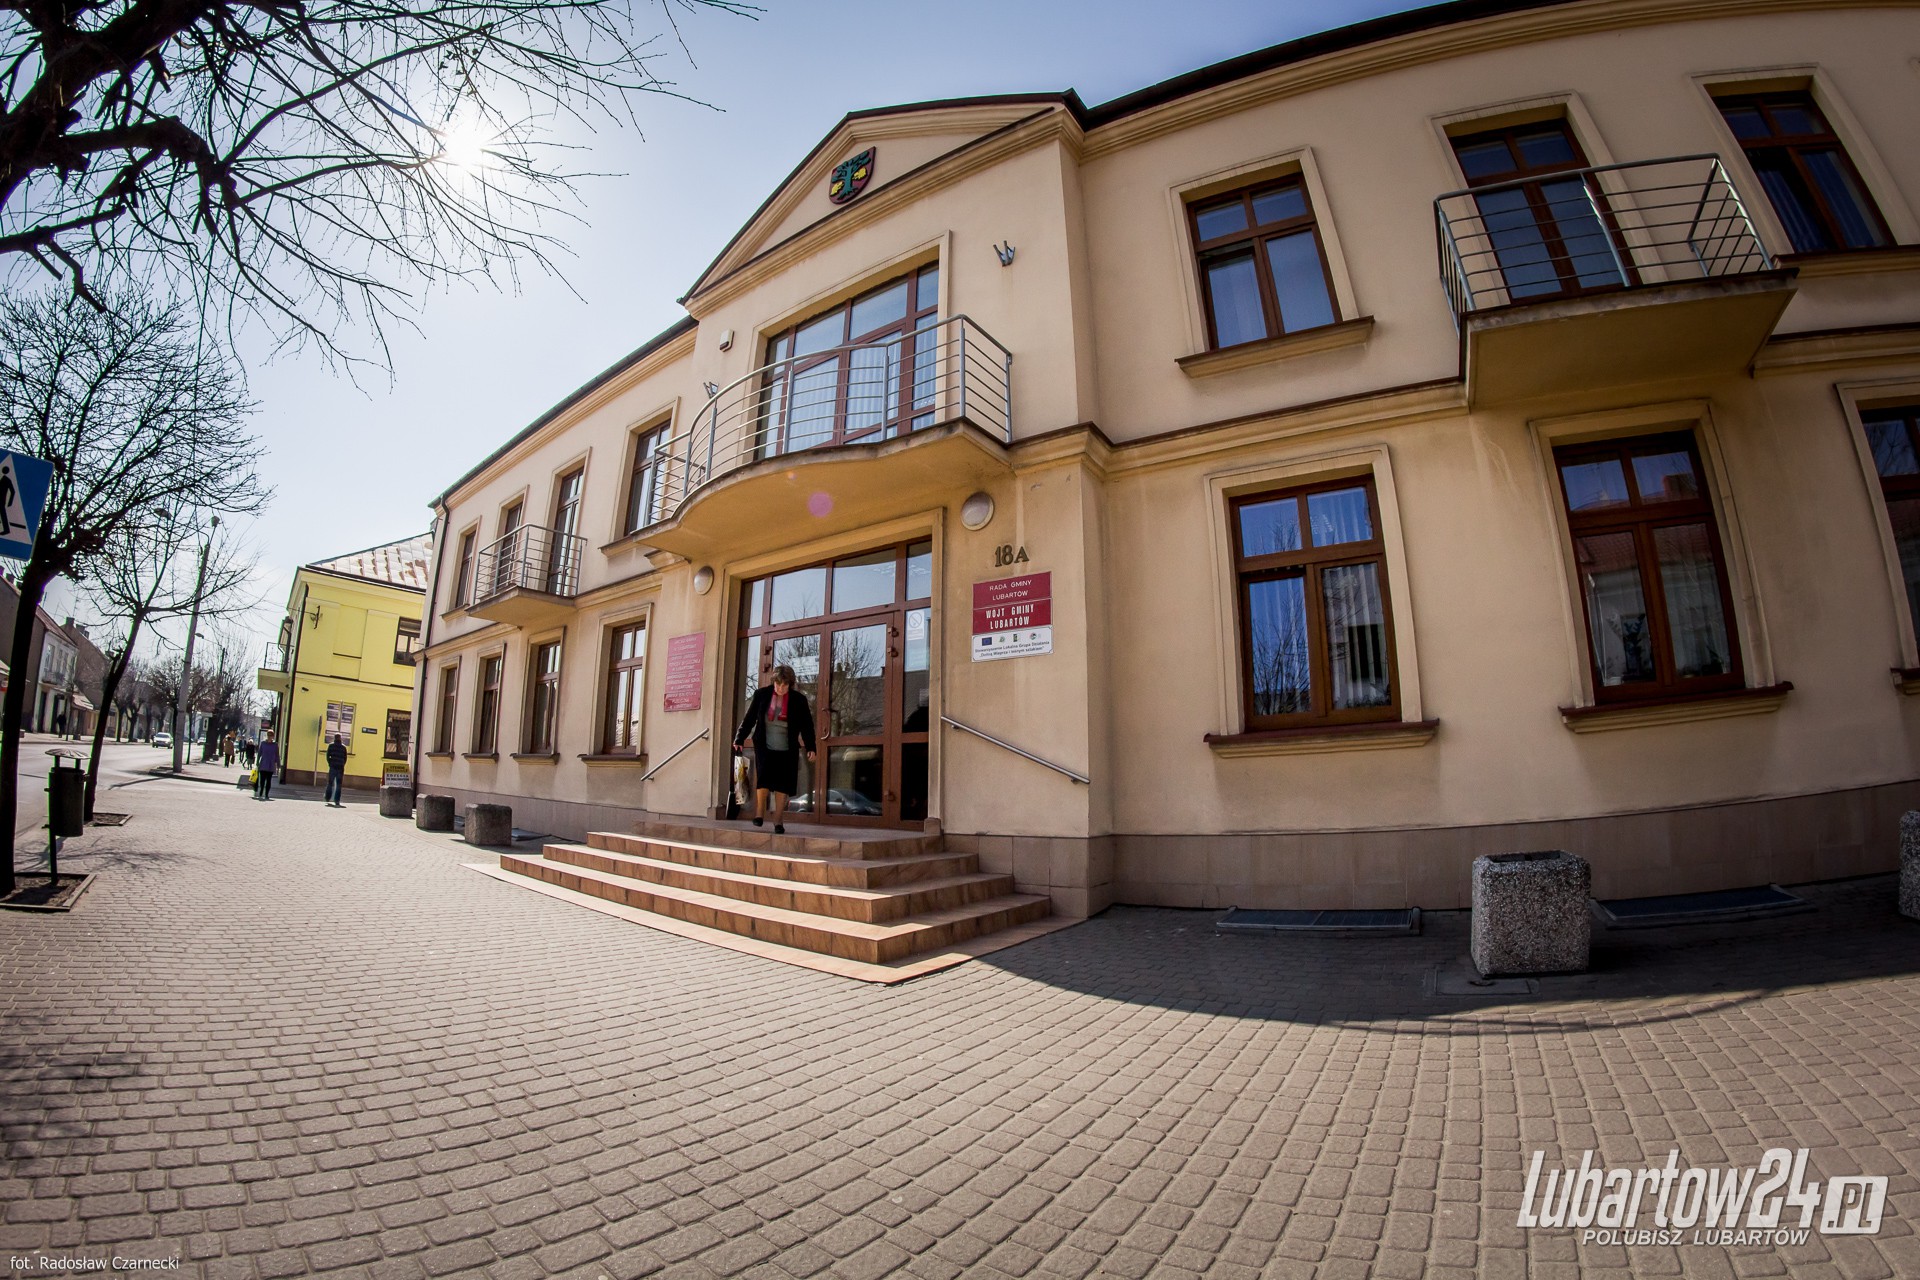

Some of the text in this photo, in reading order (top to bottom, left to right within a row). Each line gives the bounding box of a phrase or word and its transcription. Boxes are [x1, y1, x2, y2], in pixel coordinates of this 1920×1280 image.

[995, 545, 1029, 567] 18A
[989, 580, 1032, 591] RADA GMINY
[1012, 604, 1034, 615] GMINY
[990, 616, 1030, 629] LUBARTÓW
